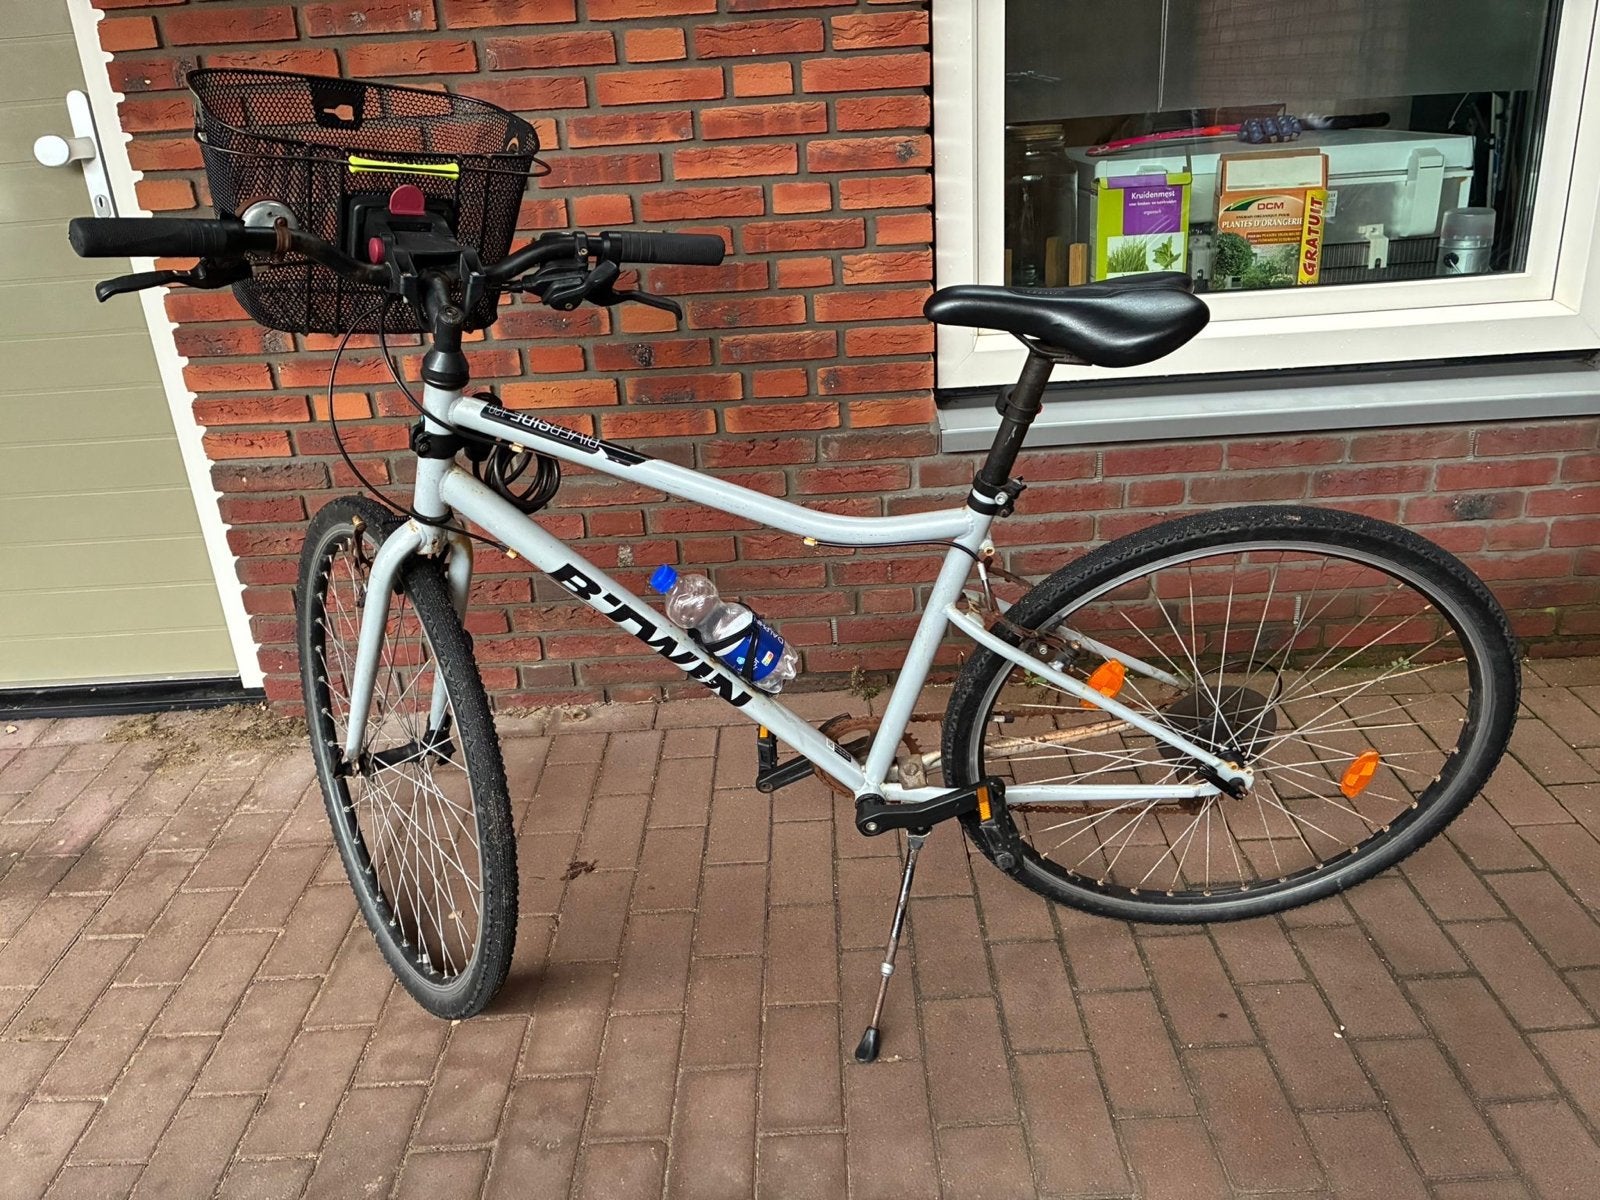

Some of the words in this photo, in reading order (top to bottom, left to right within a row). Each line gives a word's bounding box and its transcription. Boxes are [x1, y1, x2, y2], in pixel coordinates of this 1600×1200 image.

[1131, 190, 1175, 200] Kruidenmest
[1257, 202, 1284, 211] DCM
[1221, 219, 1252, 229] PLANTES
[1303, 197, 1322, 276] GRATUIT
